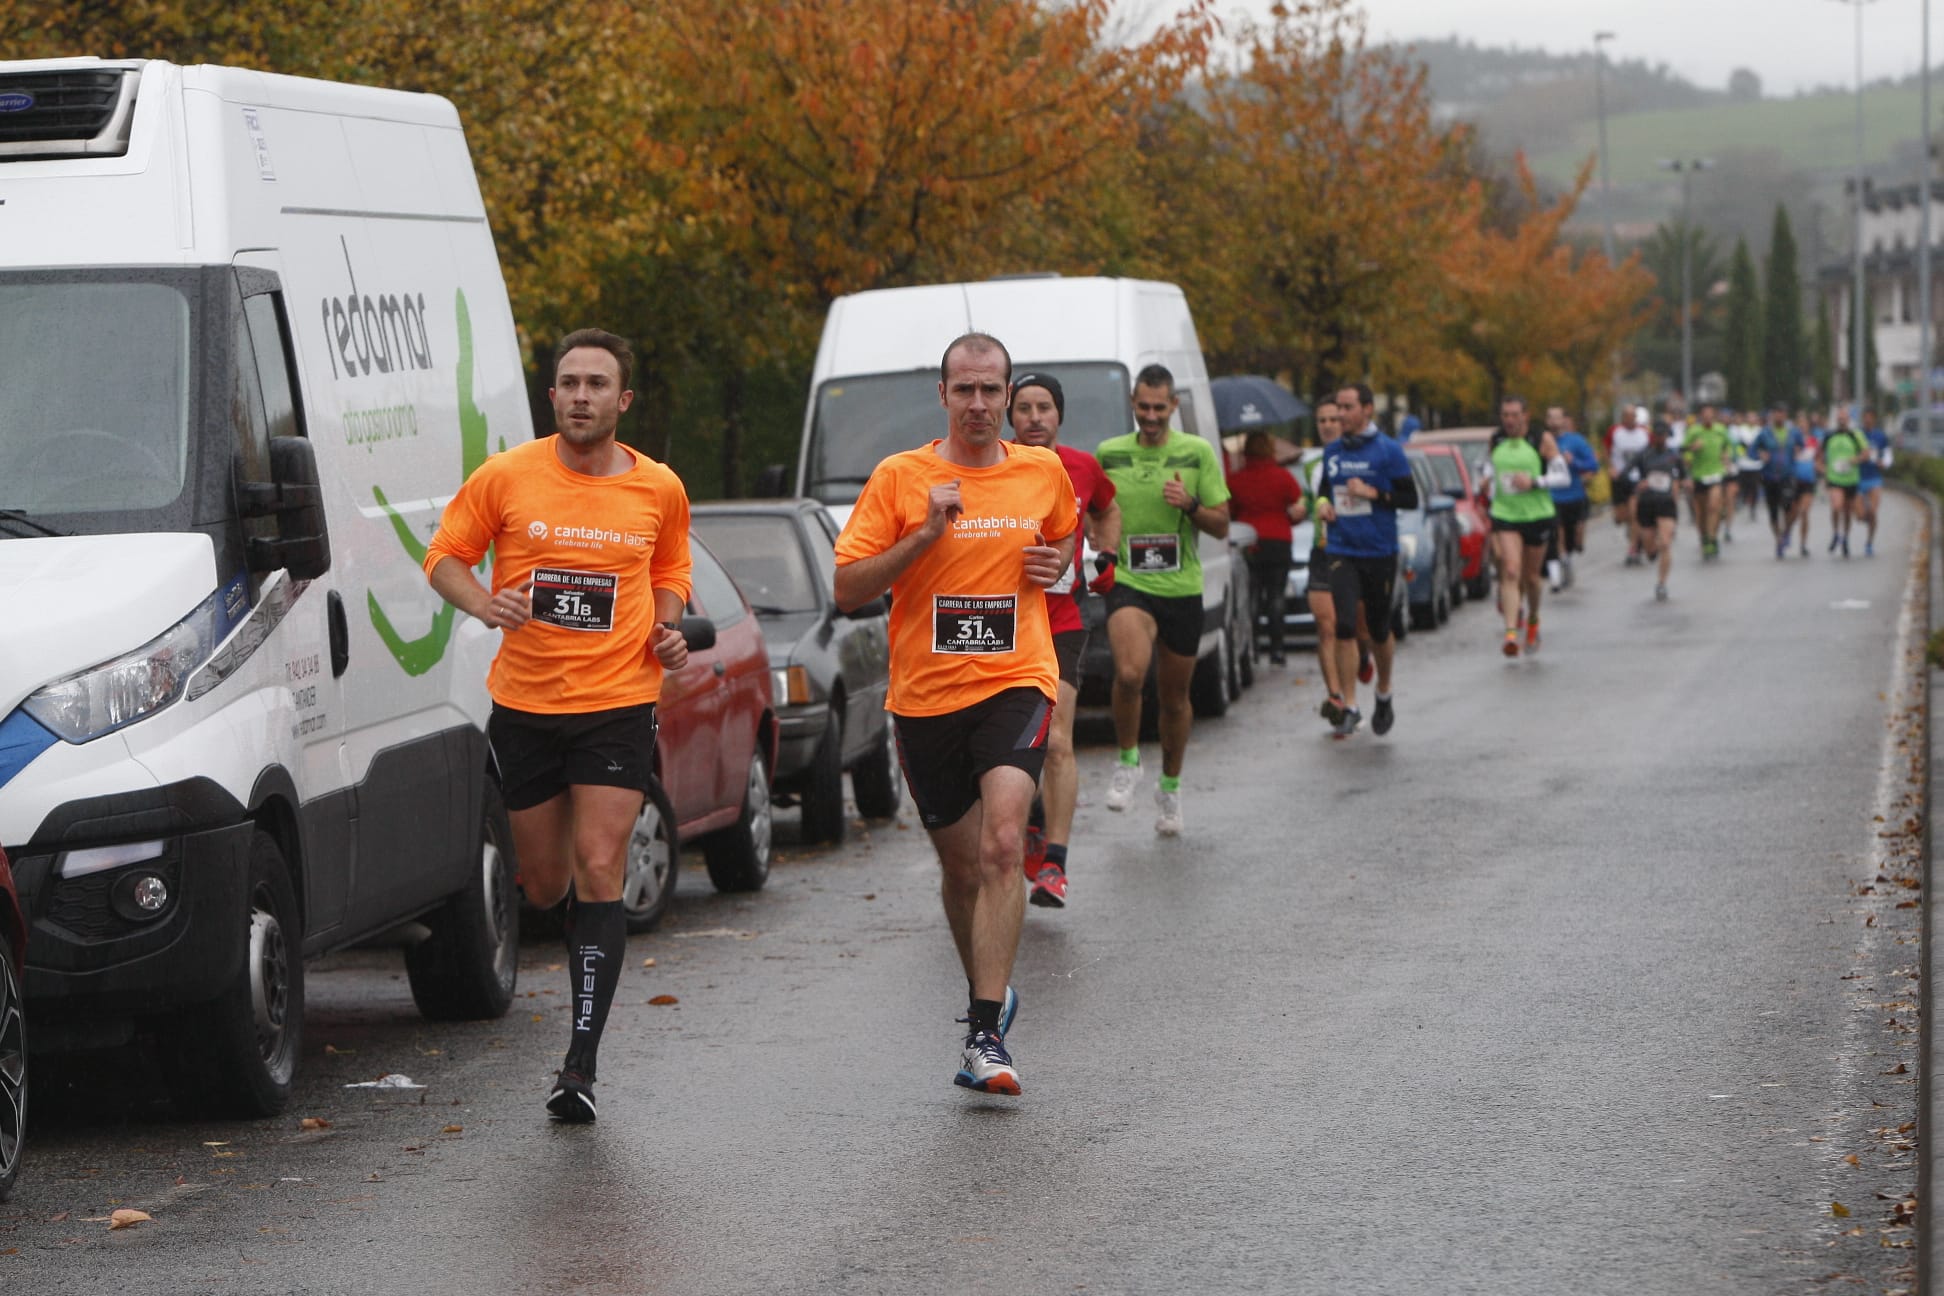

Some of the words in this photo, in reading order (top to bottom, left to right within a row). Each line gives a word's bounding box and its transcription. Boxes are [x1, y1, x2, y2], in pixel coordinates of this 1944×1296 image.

[322, 234, 432, 380] redamar
[954, 515, 1017, 530] cantabria
[1019, 515, 1040, 530] labs
[554, 526, 621, 543] cantabria
[624, 532, 647, 546] labs
[953, 531, 988, 539] celebrate
[989, 529, 1001, 537] life
[554, 538, 589, 548] celebrate
[590, 541, 603, 550] life
[536, 572, 561, 583] CARRERA
[562, 575, 571, 584] DE
[571, 576, 582, 585] LAS
[583, 577, 613, 587] EMPRESAS
[553, 594, 592, 616] 31B
[938, 599, 963, 608] CARRERA
[964, 600, 972, 609] DE
[972, 600, 984, 609] LAS
[984, 599, 1013, 609] EMPRESAS
[542, 611, 582, 622] CANTABRIA
[956, 619, 996, 640] 31A
